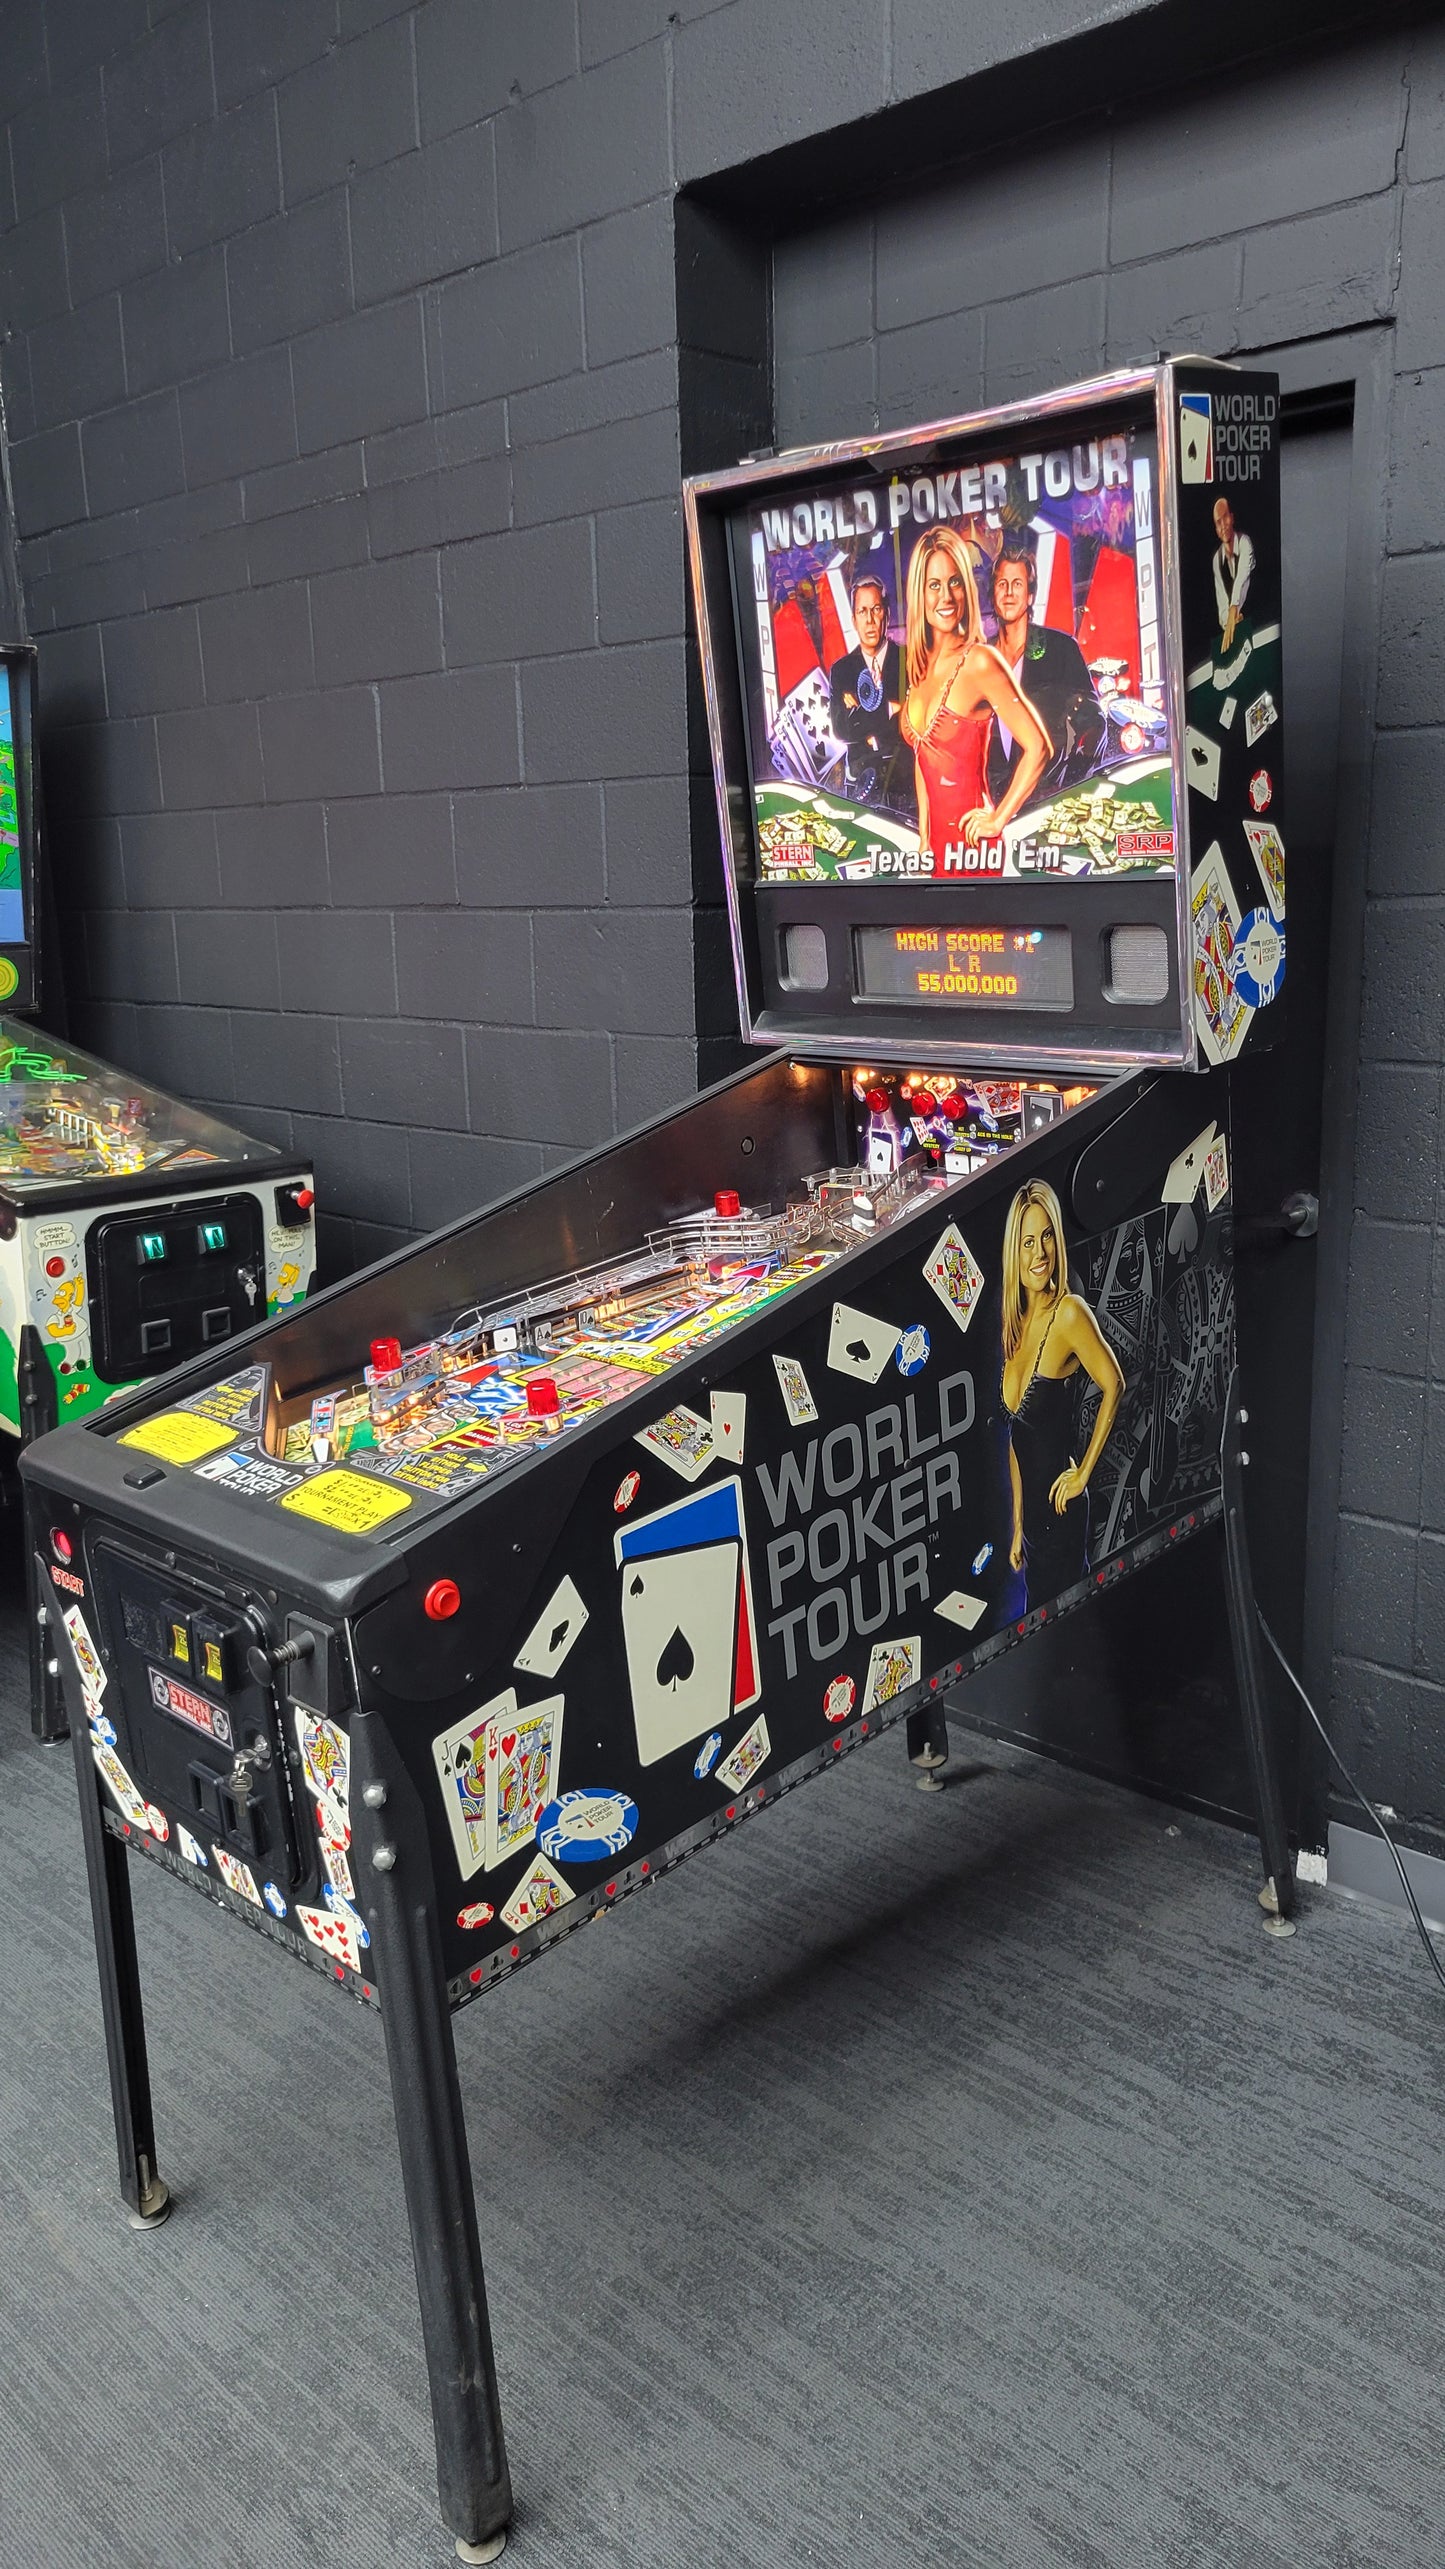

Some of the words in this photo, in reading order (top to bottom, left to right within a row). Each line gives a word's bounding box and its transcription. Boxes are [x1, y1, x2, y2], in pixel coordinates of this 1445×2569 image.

[1214, 395, 1276, 421] WORLD
[1215, 425, 1271, 451] POKER
[1215, 455, 1260, 481] TOUR
[761, 490, 877, 552] WORLD
[888, 463, 1007, 527] POKER
[1020, 438, 1128, 502] TOUR
[774, 845, 812, 860] STERN
[1120, 835, 1171, 849] SRP
[867, 844, 934, 872] Texas
[945, 841, 1002, 870] Hold
[896, 932, 938, 951] HIGH
[946, 934, 1005, 952] SCORE
[1262, 938, 1278, 946] WORLD
[948, 954, 961, 972] L
[968, 955, 981, 972] R
[918, 973, 1017, 995] 55,000,000
[444, 1452, 467, 1462] HOLD
[755, 1370, 975, 1528] WORLD
[226, 1469, 282, 1494] POKER
[245, 1460, 303, 1486] WORLD
[300, 1486, 358, 1510] TOURNAMENT
[766, 1450, 962, 1609] POKER
[52, 1565, 84, 1597] START
[768, 1541, 930, 1681] TOUR
[170, 1684, 211, 1723] STERN
[489, 1726, 498, 1747] K
[441, 1739, 449, 1761] J
[583, 1801, 610, 1815] WORLD
[589, 1806, 612, 1820] POKER
[594, 1811, 614, 1824] TOUR
[165, 1848, 212, 1890] WORLD
[266, 1917, 307, 1956] TOUR
